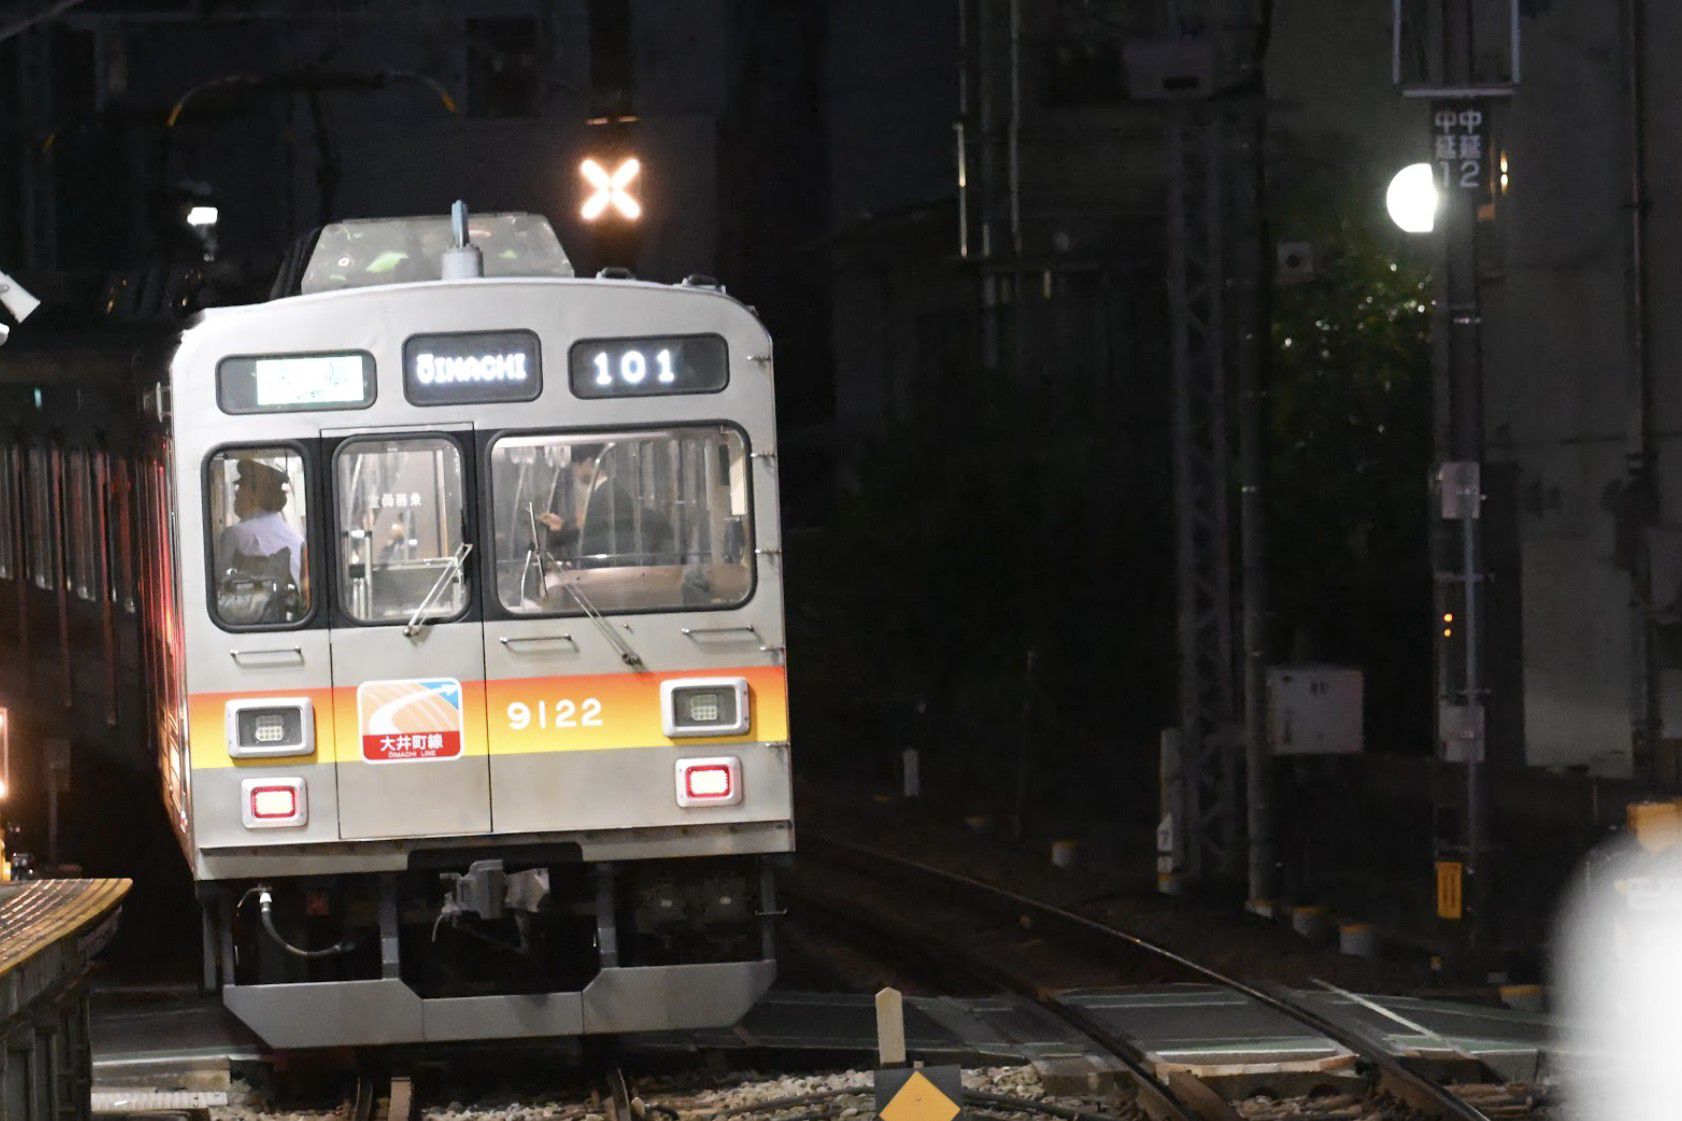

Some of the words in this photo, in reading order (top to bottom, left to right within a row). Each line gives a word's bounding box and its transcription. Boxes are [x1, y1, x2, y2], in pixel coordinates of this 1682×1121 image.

[594, 350, 674, 384] 101
[507, 698, 603, 729] 9122
[380, 734, 443, 751] 大井町線
